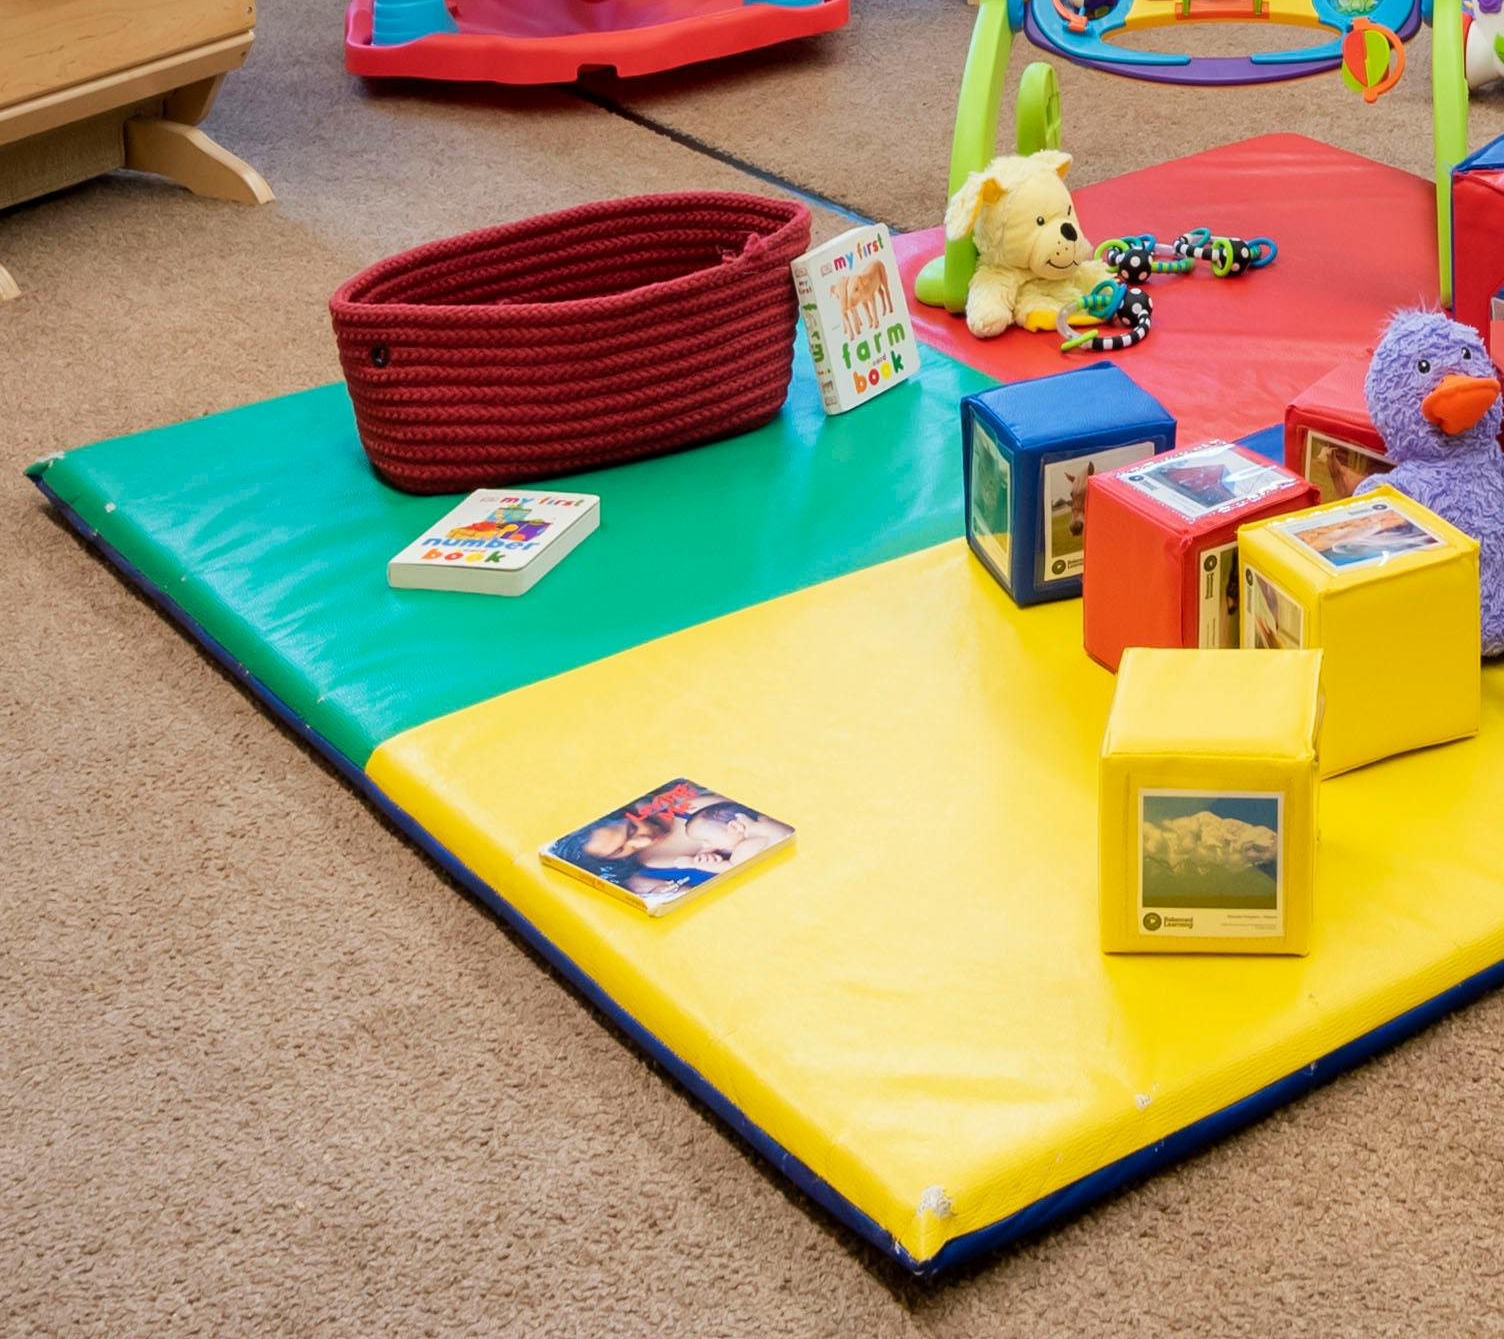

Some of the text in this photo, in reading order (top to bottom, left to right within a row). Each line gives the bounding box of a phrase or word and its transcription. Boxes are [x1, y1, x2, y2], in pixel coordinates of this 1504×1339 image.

[833, 251, 854, 272] my
[856, 232, 885, 260] first
[842, 323, 906, 370] farm
[852, 350, 905, 395] book
[500, 496, 533, 505] my
[538, 496, 585, 507] first
[420, 548, 506, 563] book
[422, 537, 540, 551] number
